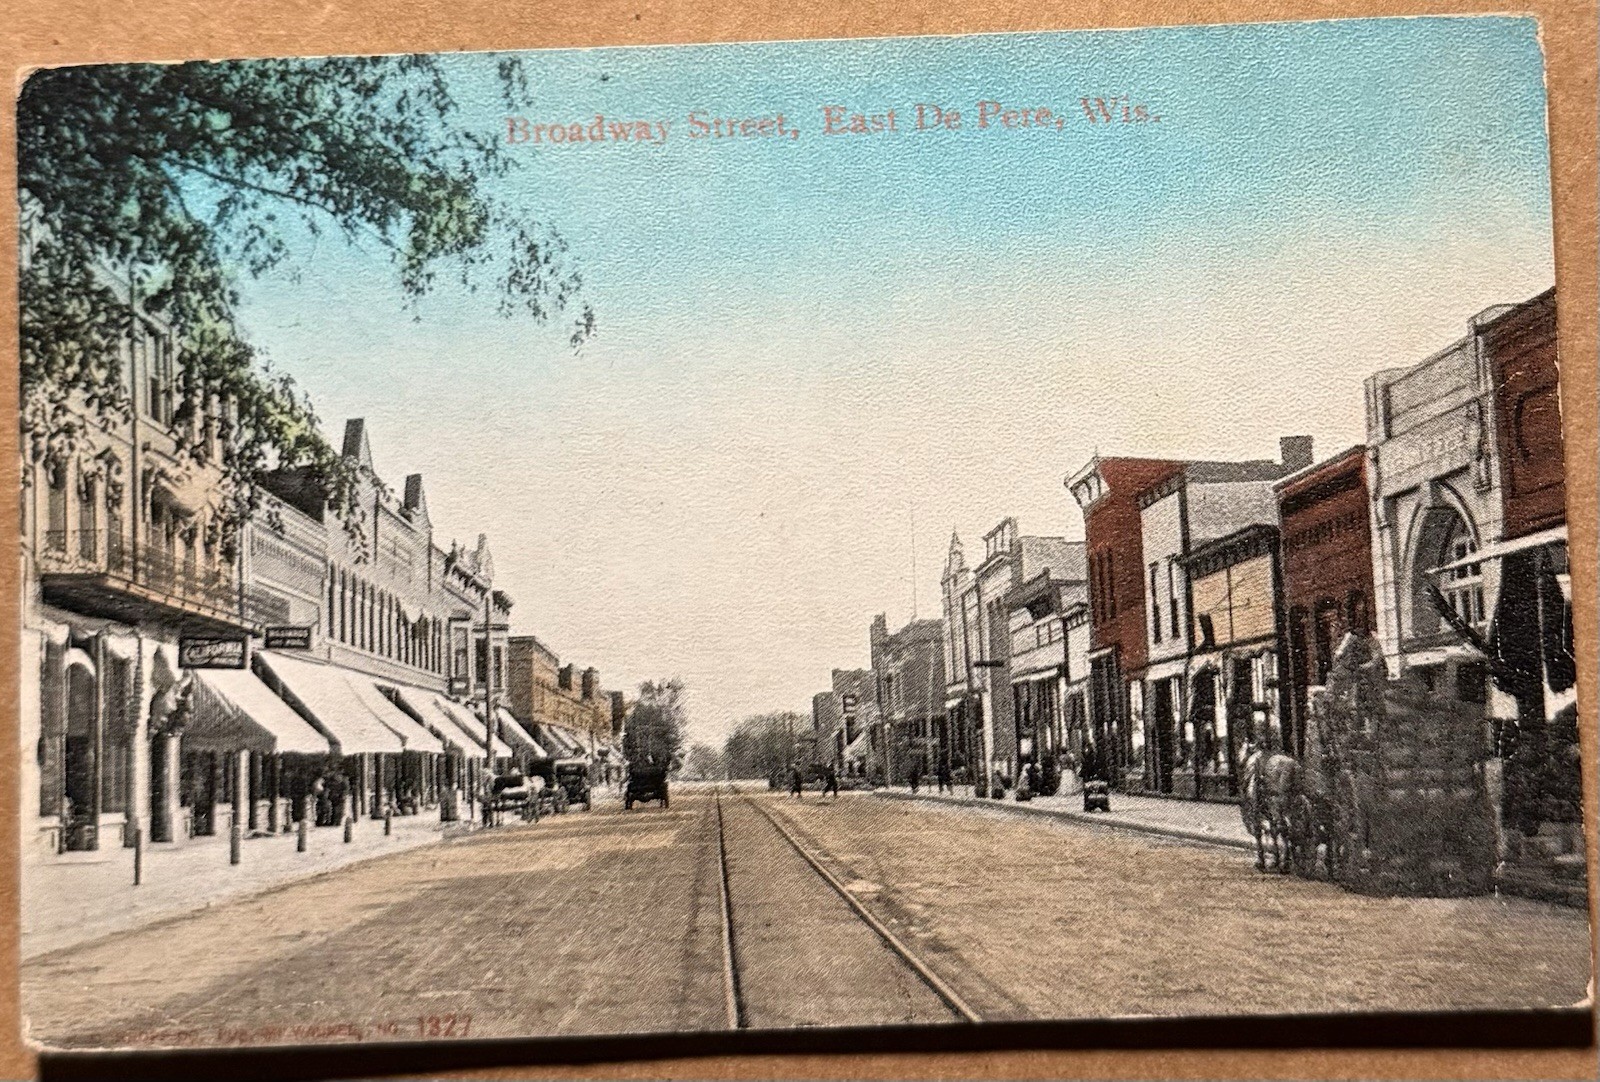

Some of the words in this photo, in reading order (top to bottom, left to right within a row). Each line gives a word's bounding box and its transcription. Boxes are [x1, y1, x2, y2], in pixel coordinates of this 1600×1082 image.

[504, 114, 672, 147] Broadway
[687, 109, 801, 141] Street,
[820, 104, 899, 136] East
[913, 102, 962, 132] De
[977, 99, 1065, 132] Pere,
[1079, 94, 1163, 125] Wis.
[418, 1012, 474, 1037] 1327
